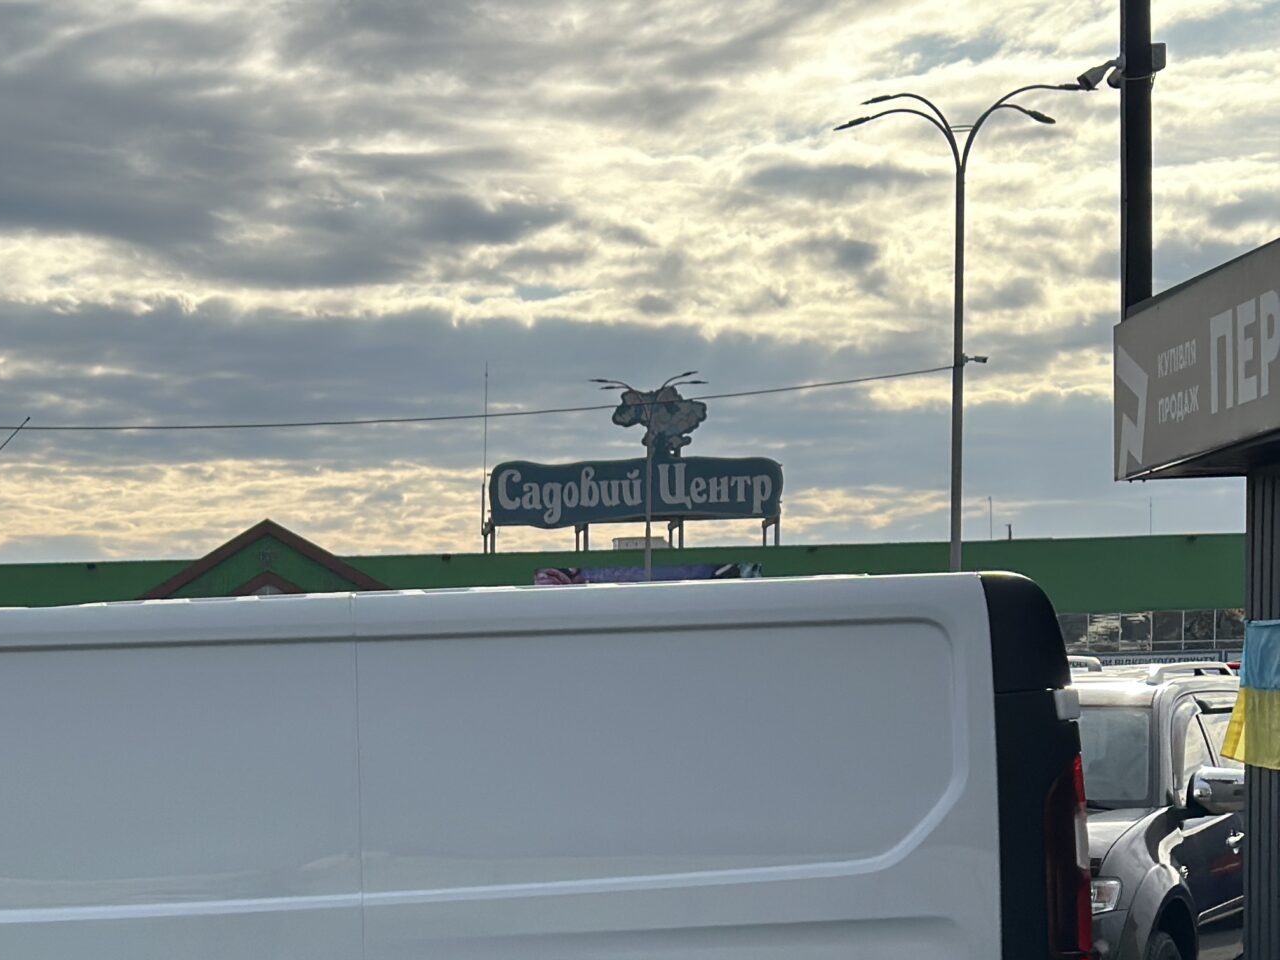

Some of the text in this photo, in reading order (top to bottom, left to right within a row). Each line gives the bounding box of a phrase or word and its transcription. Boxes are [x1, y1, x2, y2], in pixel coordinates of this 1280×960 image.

[1157, 338, 1197, 378] КУПІВЛЯ
[1158, 385, 1200, 425] ПРОДАЖ
[497, 462, 773, 525] Садовий Центр
